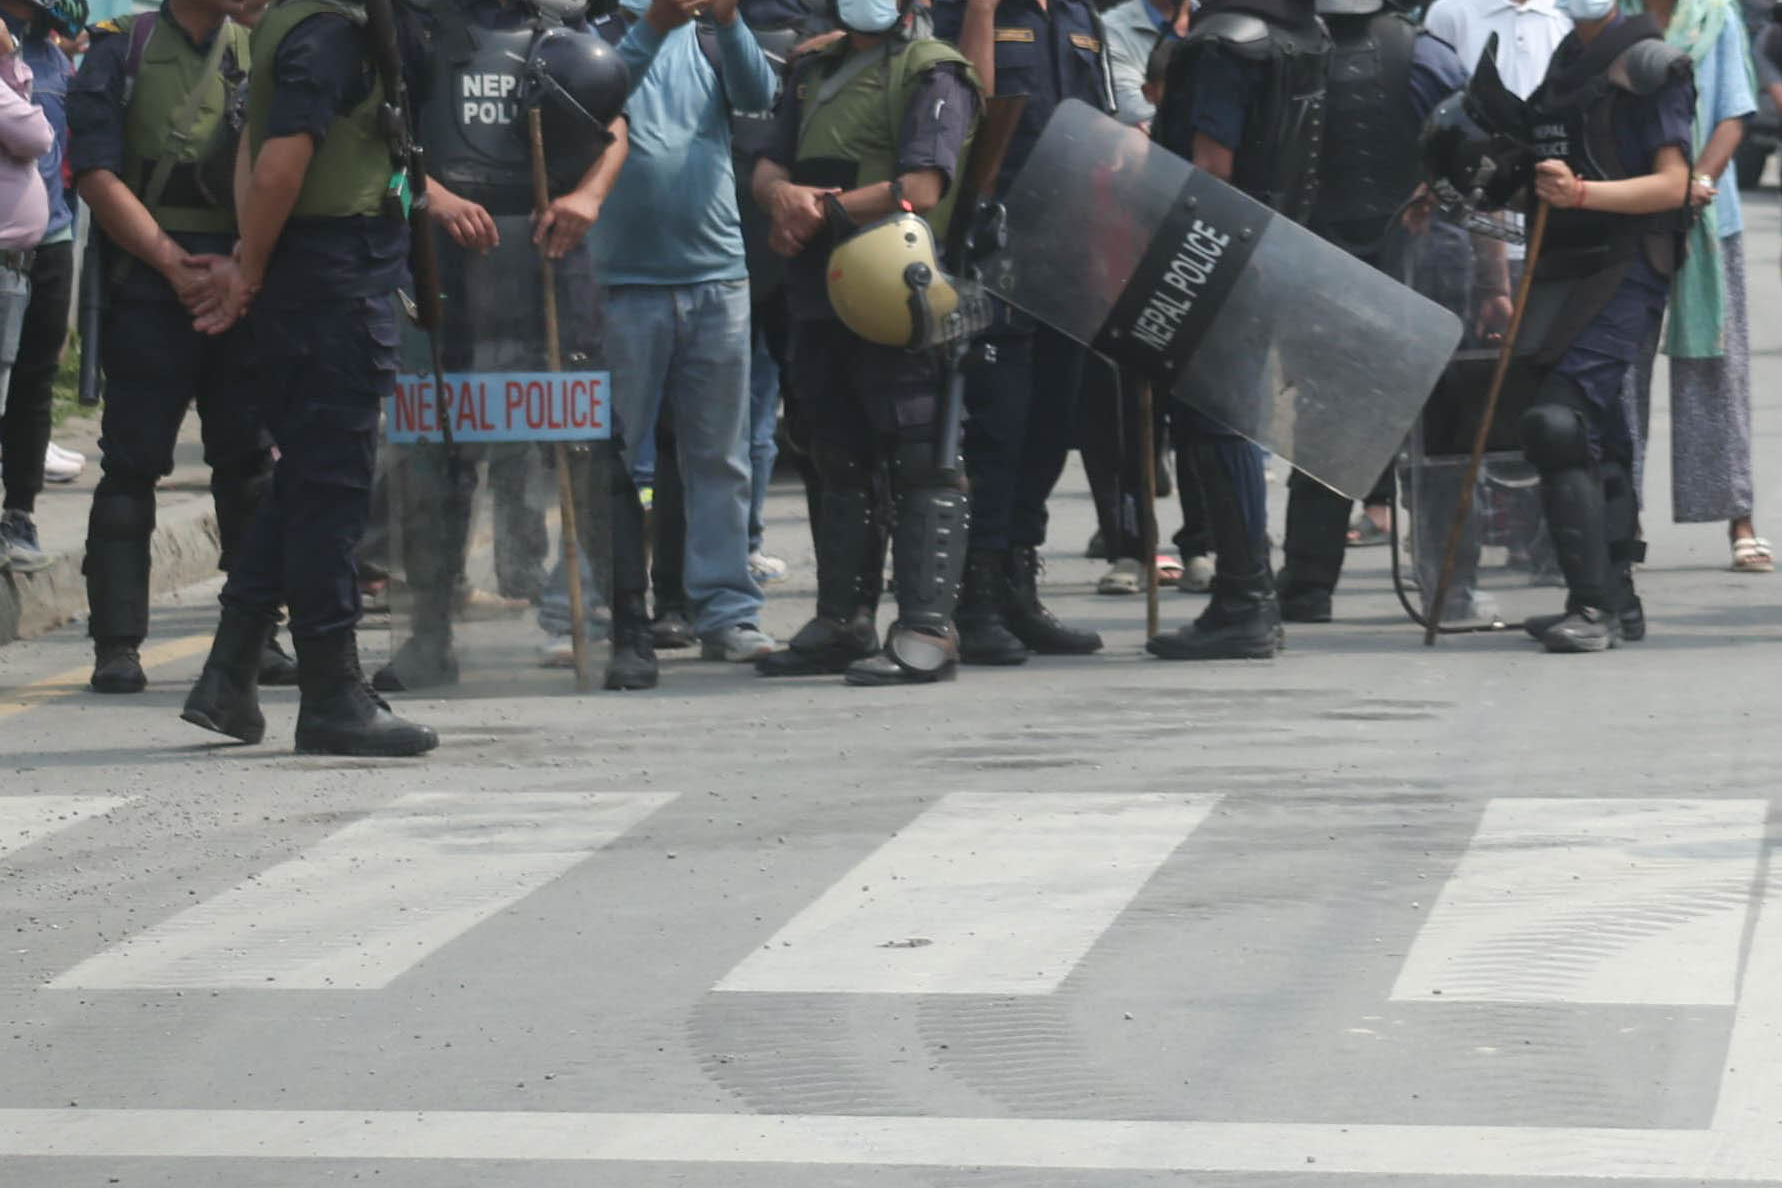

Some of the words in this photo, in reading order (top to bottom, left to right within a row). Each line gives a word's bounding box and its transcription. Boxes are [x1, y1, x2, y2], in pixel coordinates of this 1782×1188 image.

[462, 74, 523, 98] NEP
[463, 102, 518, 125] POL
[1130, 290, 1192, 351] NEPAL
[1162, 219, 1230, 298] POLICE
[505, 379, 604, 430] POLICE
